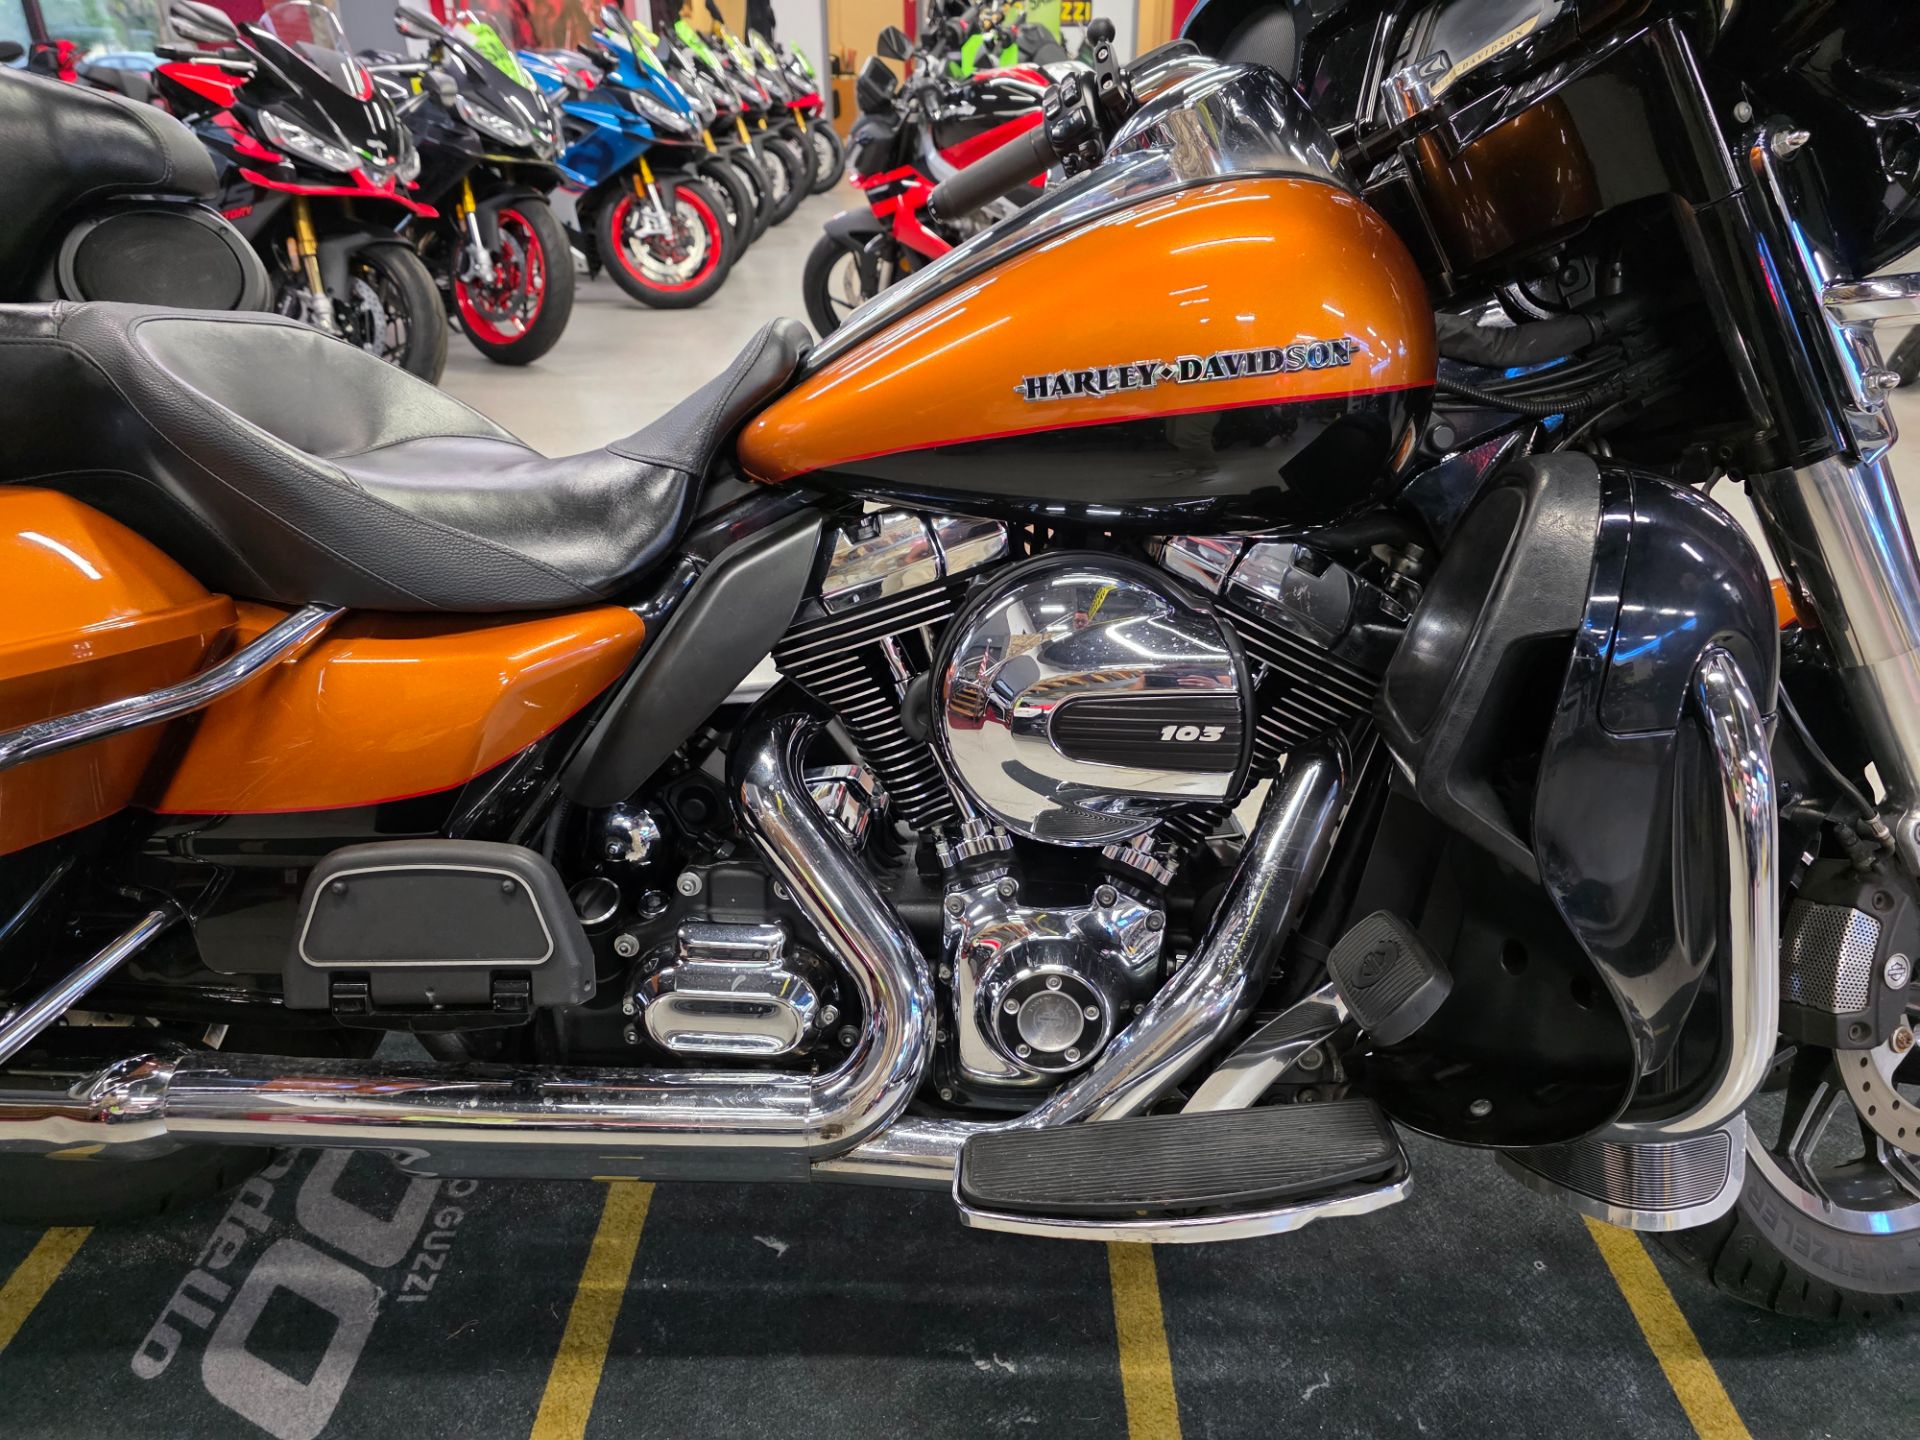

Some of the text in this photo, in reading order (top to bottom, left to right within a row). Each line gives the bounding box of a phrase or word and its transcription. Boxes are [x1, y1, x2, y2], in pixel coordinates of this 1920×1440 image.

[1060, 1, 1091, 21] ZZI
[223, 204, 254, 220] TORY
[1023, 338, 1352, 400] HARLEY DAVIDSON
[1160, 725, 1225, 741] 103
[131, 1150, 298, 1380] ndello
[396, 1206, 464, 1301] GUZZI
